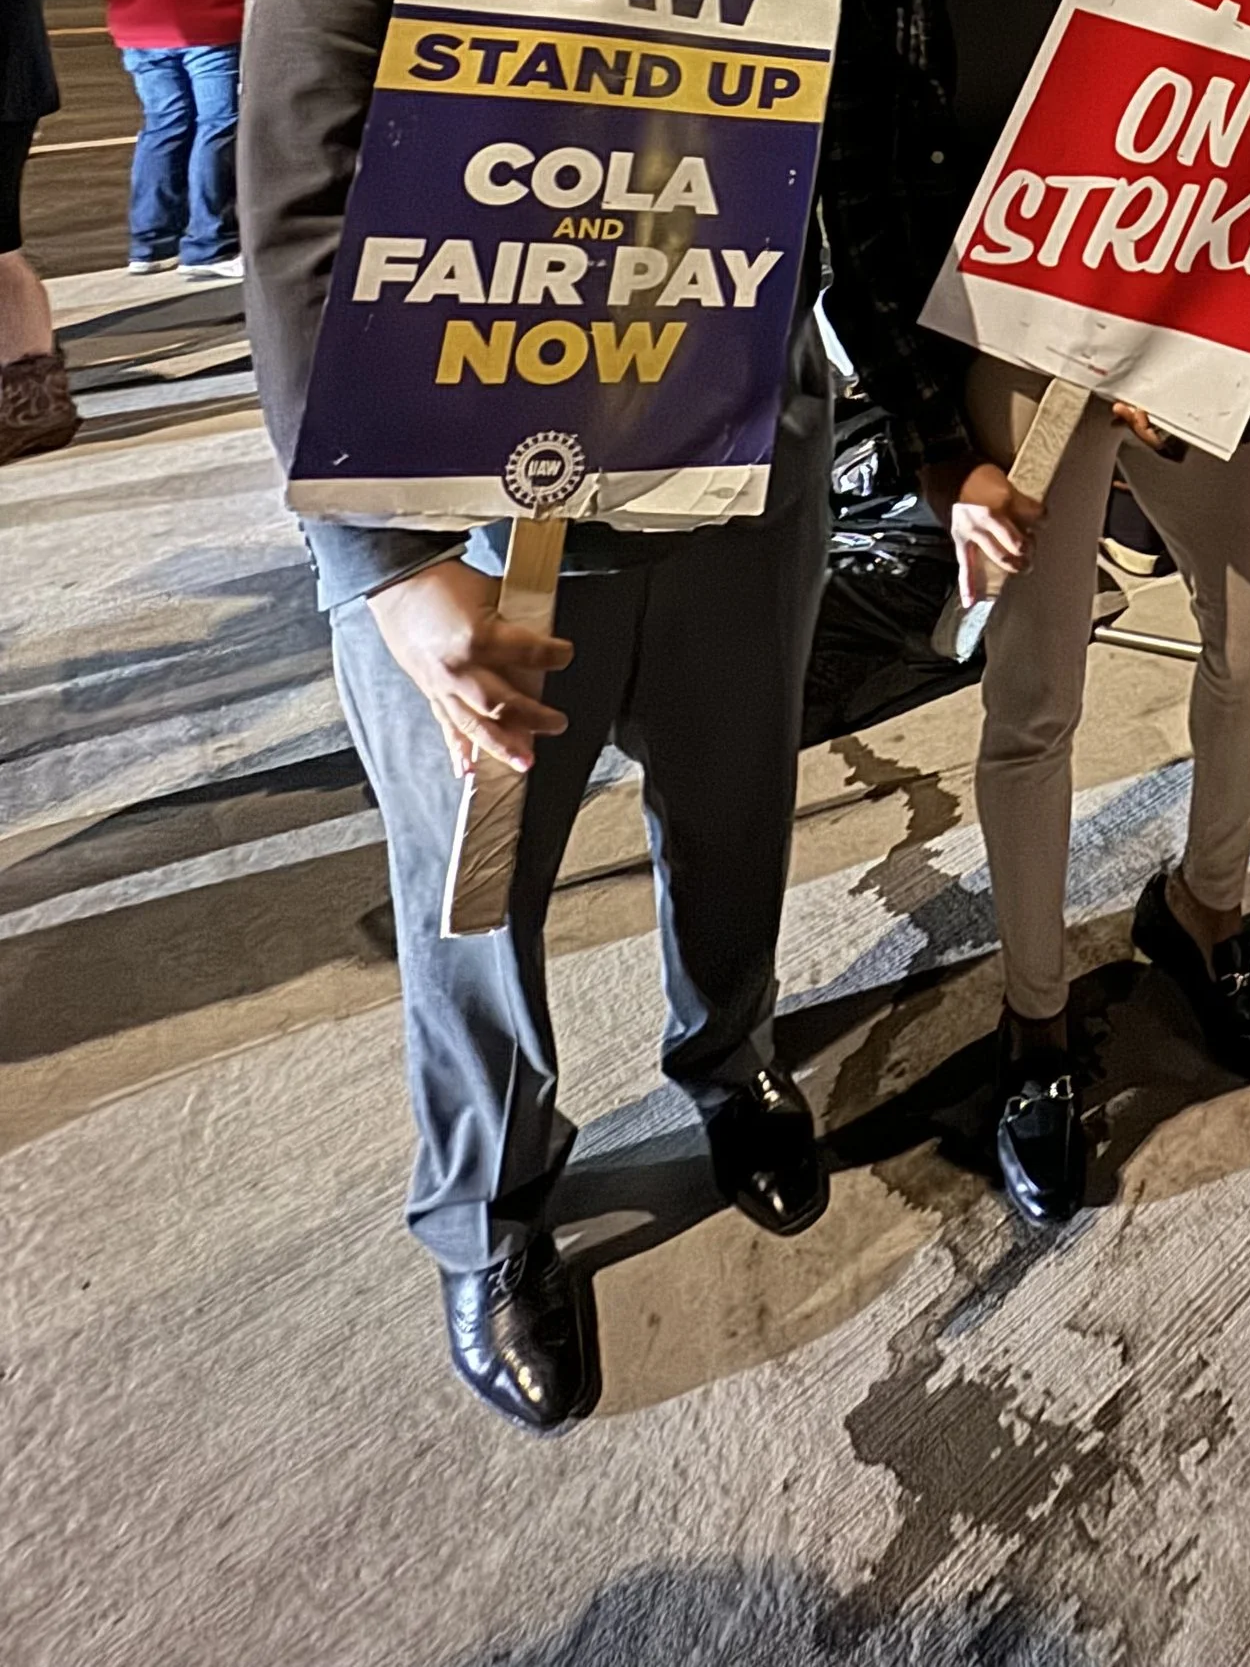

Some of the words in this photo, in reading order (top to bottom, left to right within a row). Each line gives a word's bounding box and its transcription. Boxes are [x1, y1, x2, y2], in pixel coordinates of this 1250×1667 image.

[409, 34, 681, 99] STAND
[707, 62, 800, 109] UP
[464, 142, 718, 215] COLA
[553, 217, 623, 240] AND
[352, 238, 593, 304] FAIR
[607, 248, 783, 307] PAY
[435, 320, 686, 384] NOW
[527, 460, 562, 476] UAW
